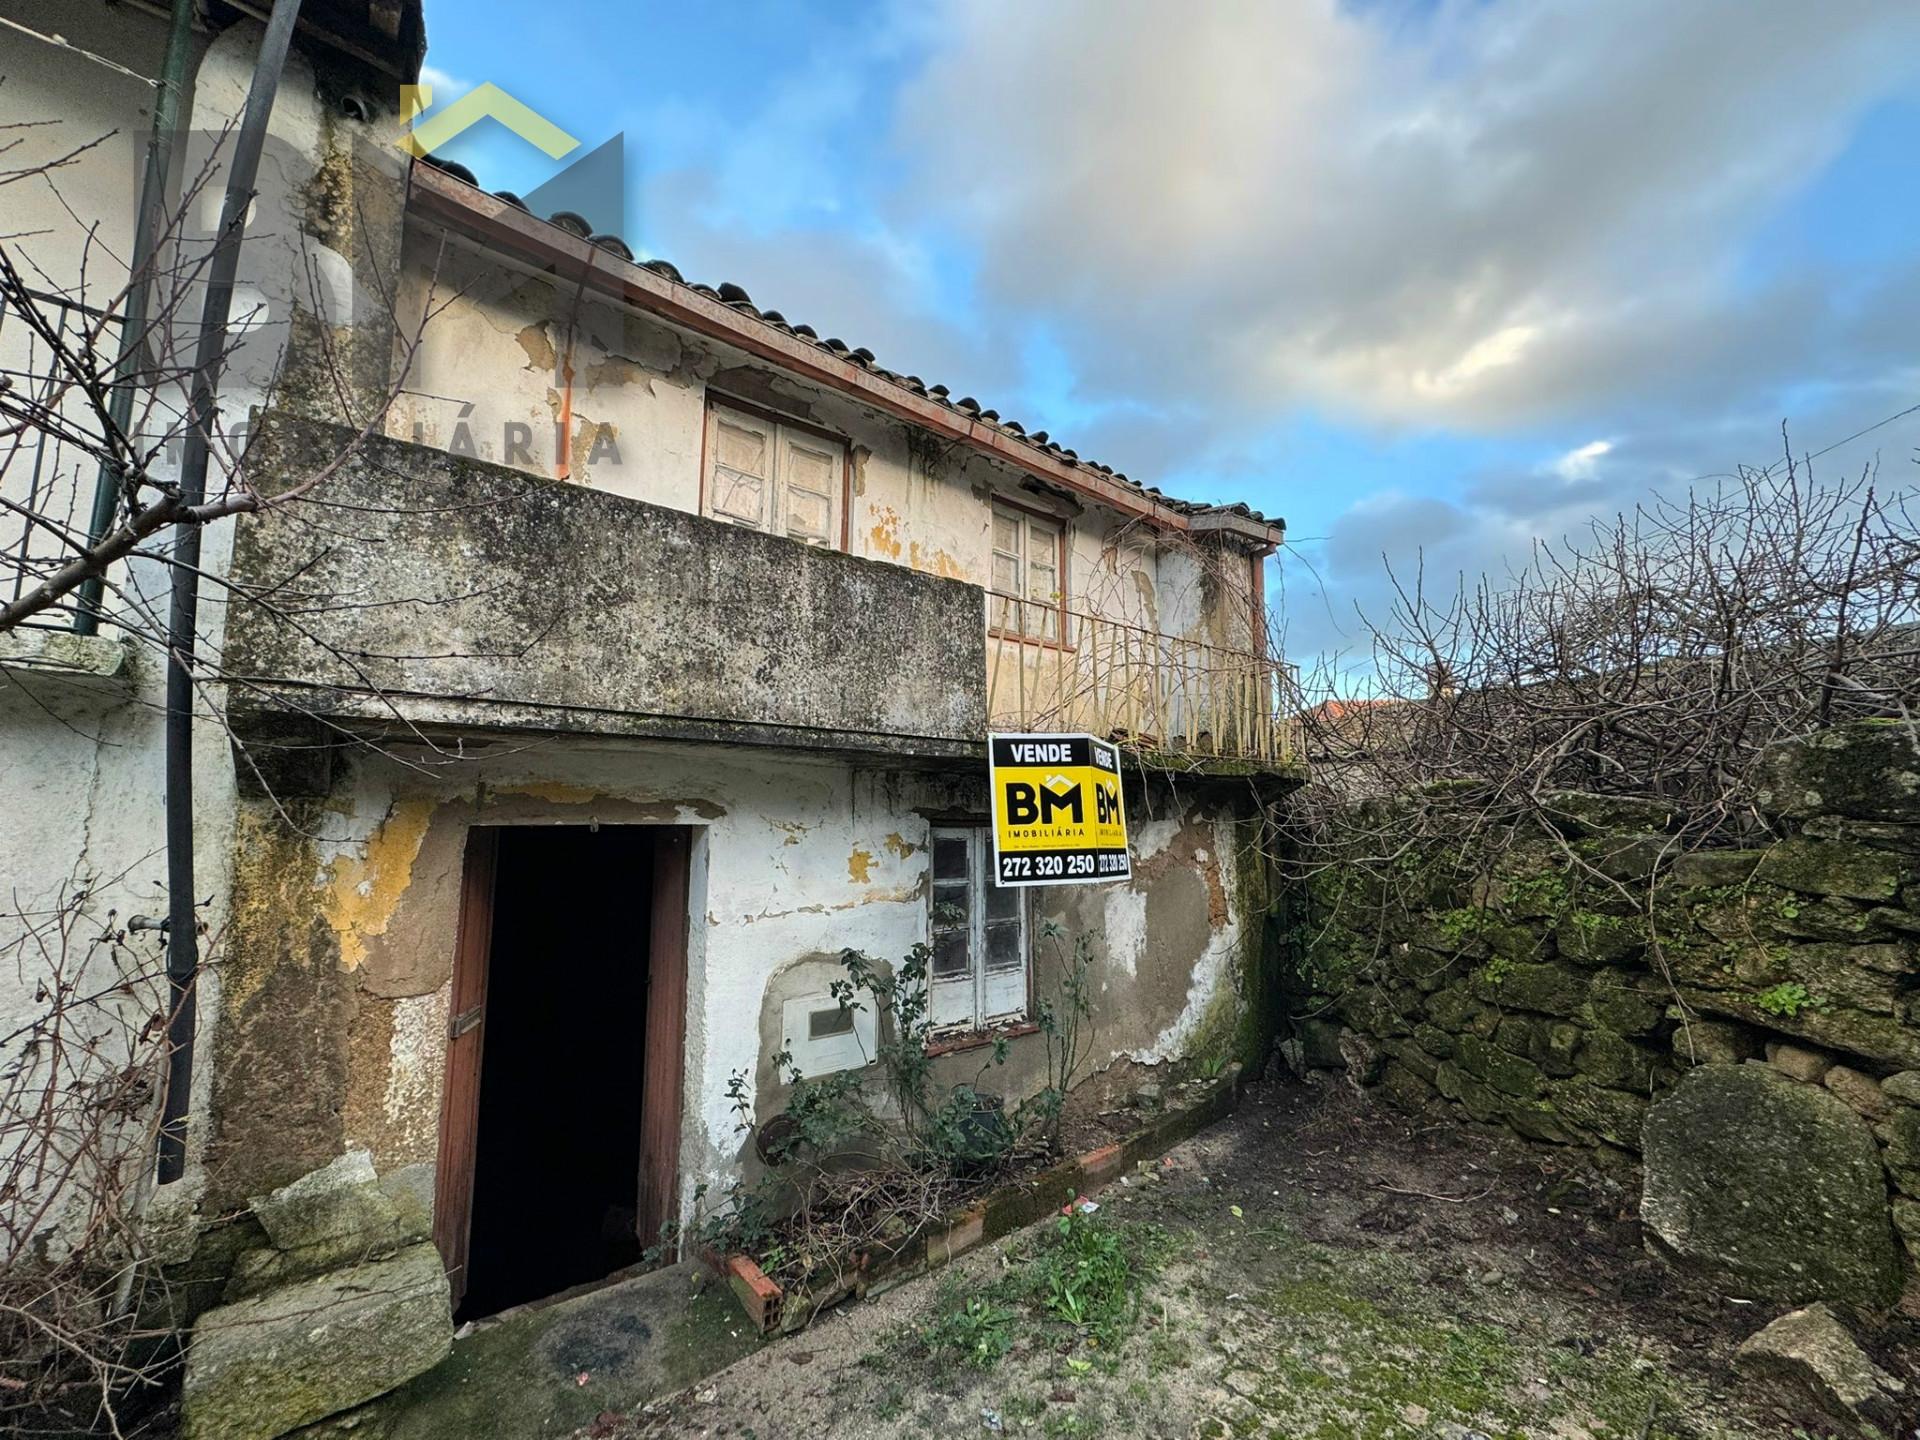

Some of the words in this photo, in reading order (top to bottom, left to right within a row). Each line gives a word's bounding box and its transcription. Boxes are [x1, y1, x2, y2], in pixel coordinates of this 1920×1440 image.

[1010, 744, 1072, 762] VENDE
[1005, 782, 1084, 825] BM
[1095, 783, 1121, 825] BM
[1008, 827, 1085, 838] IMOBILIÁRIA
[1003, 857, 1031, 877] 272
[1035, 856, 1063, 875] 320
[1067, 854, 1095, 874] 250
